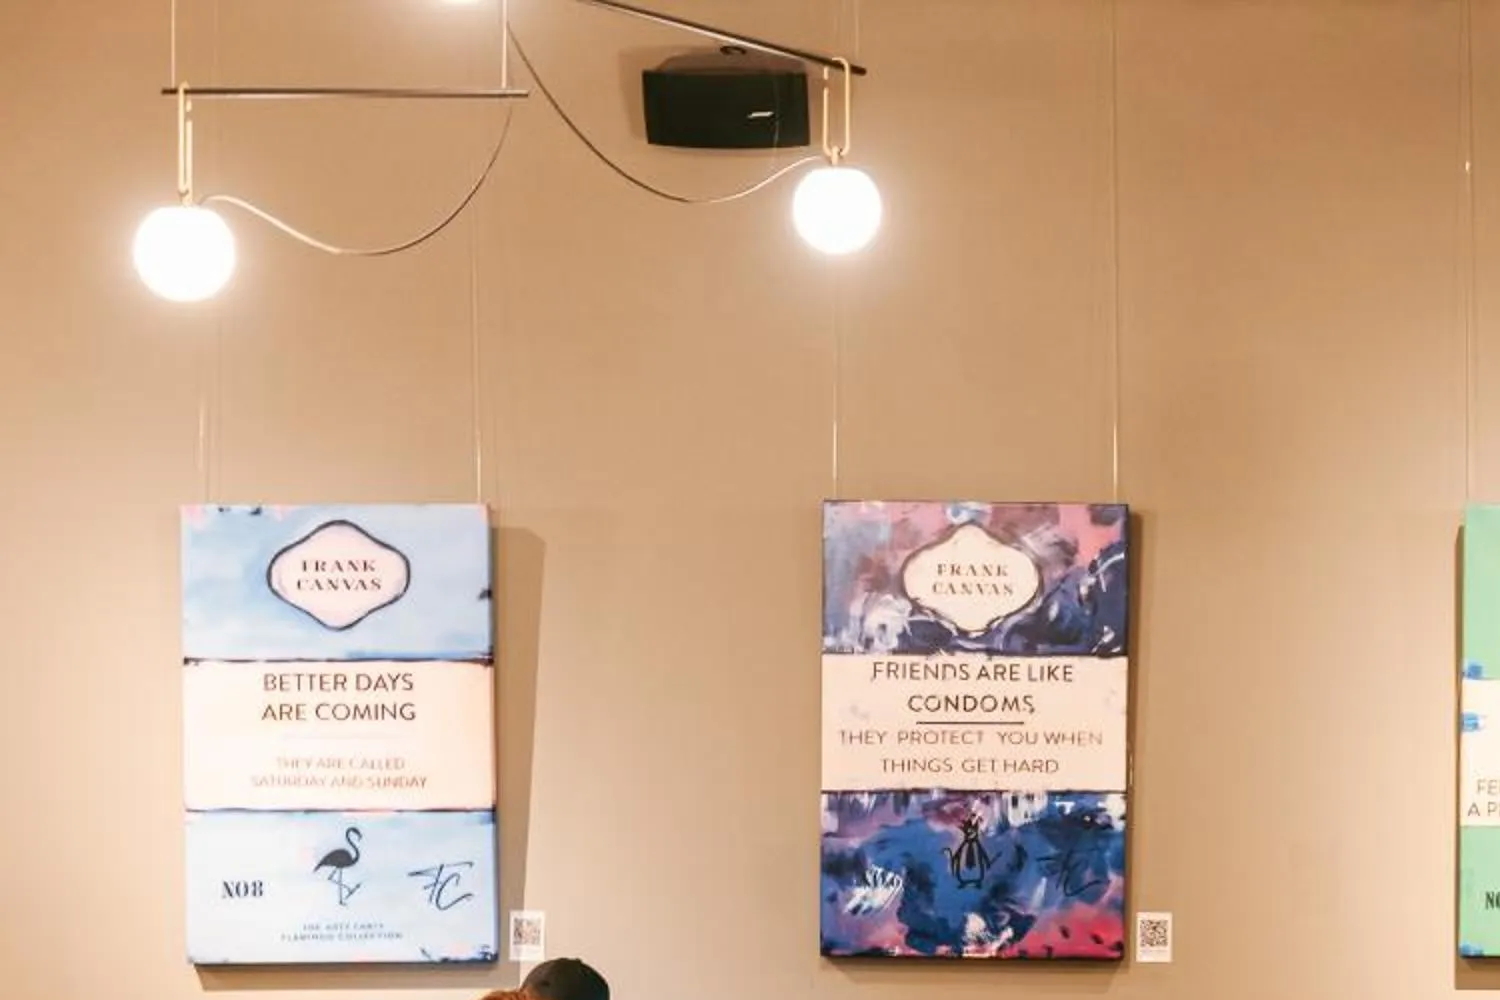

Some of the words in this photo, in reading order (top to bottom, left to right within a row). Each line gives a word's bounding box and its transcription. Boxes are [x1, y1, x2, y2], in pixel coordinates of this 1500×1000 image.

[301, 559, 376, 573] FRANK
[936, 563, 1009, 577] FRANK
[296, 578, 382, 591] CANVAS
[931, 583, 1014, 596] CANVAS
[870, 660, 970, 682] FRIENDS
[976, 663, 1021, 682] ARE
[1027, 664, 1074, 683] LIKE
[263, 672, 348, 692] BETTER
[355, 672, 415, 692] DAYS
[261, 702, 309, 721] ARE
[315, 702, 417, 721] COMING
[907, 694, 1036, 713] CONDOMS
[838, 729, 887, 745] THEY
[897, 729, 985, 745] PROTECT
[997, 729, 1039, 746] YOU
[1043, 730, 1103, 746] WHEN
[348, 757, 406, 771] CALLED
[882, 757, 954, 773] THINGS
[961, 758, 997, 774] GET
[1003, 758, 1059, 774] HARD
[366, 775, 428, 790] SUNDAY
[1467, 802, 1481, 818] A
